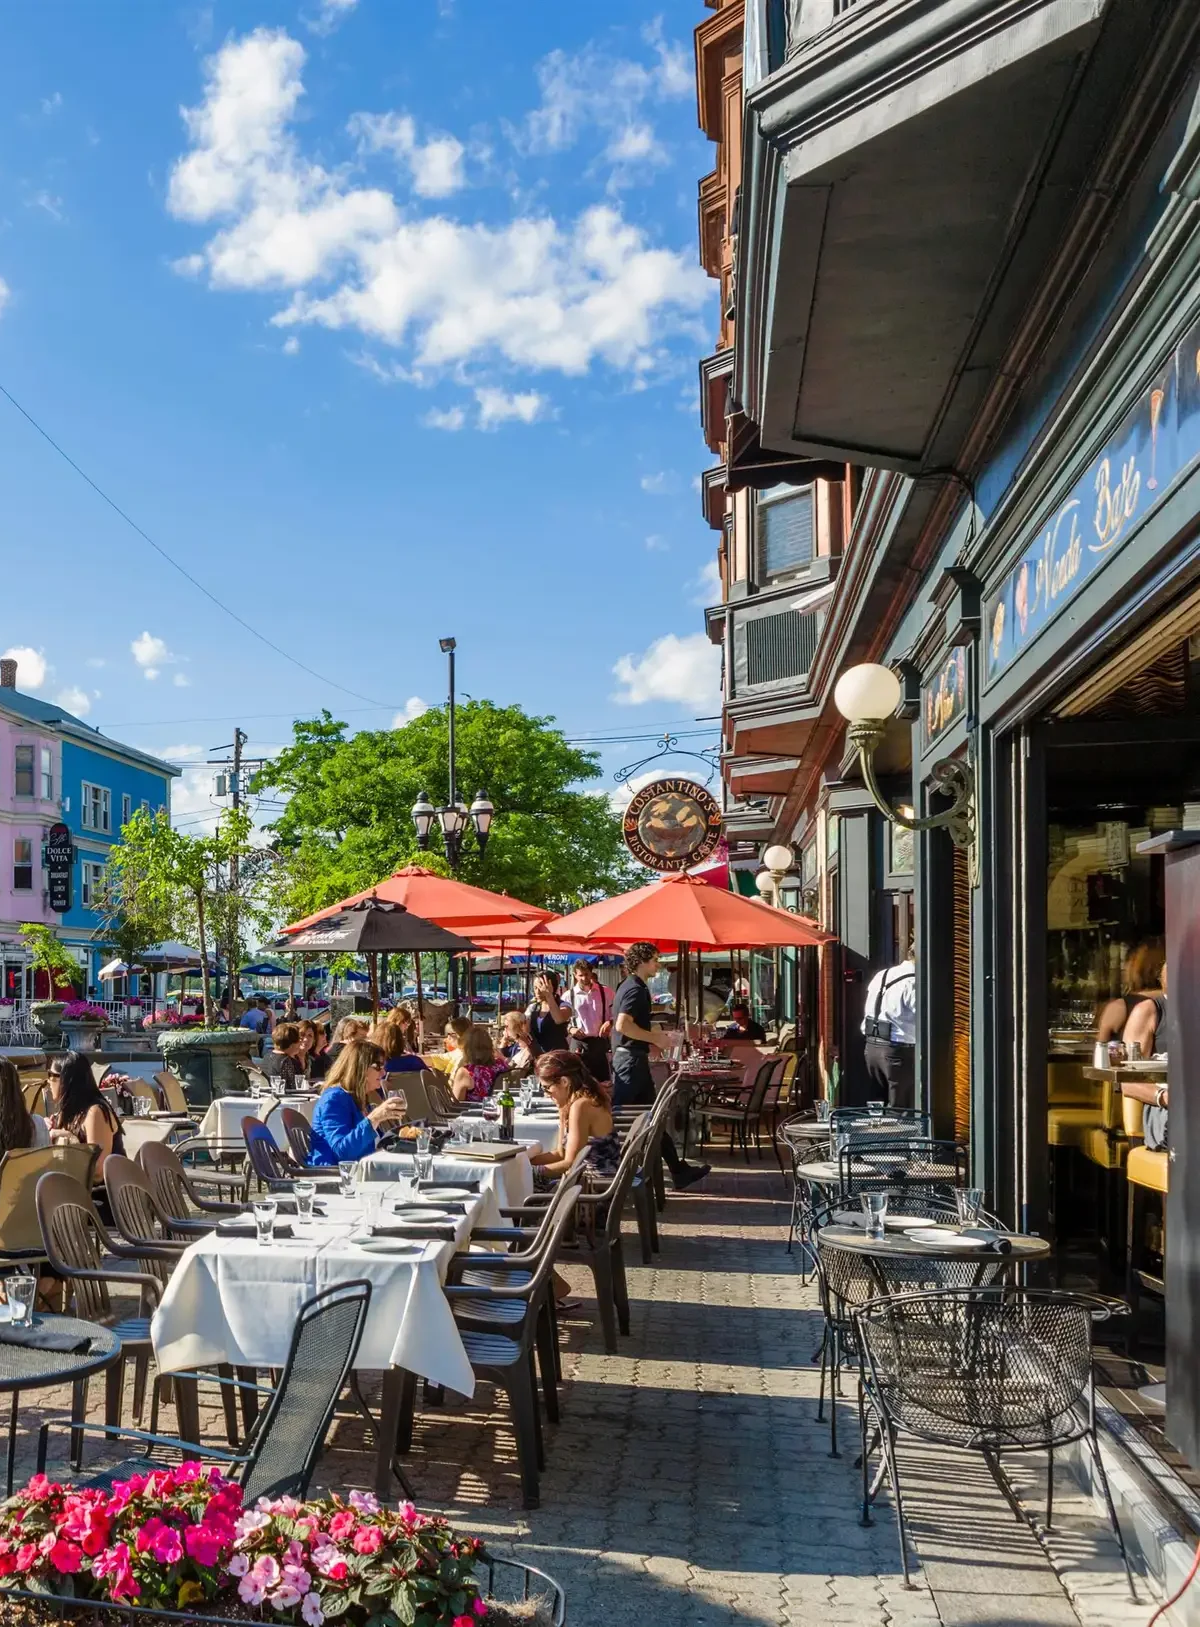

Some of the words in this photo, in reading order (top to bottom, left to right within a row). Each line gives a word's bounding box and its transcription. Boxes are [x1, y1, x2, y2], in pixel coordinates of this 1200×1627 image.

[629, 780, 718, 815] COSTANTINO'S
[47, 847, 72, 855] DOLCE
[628, 834, 689, 869] RISTORANTE
